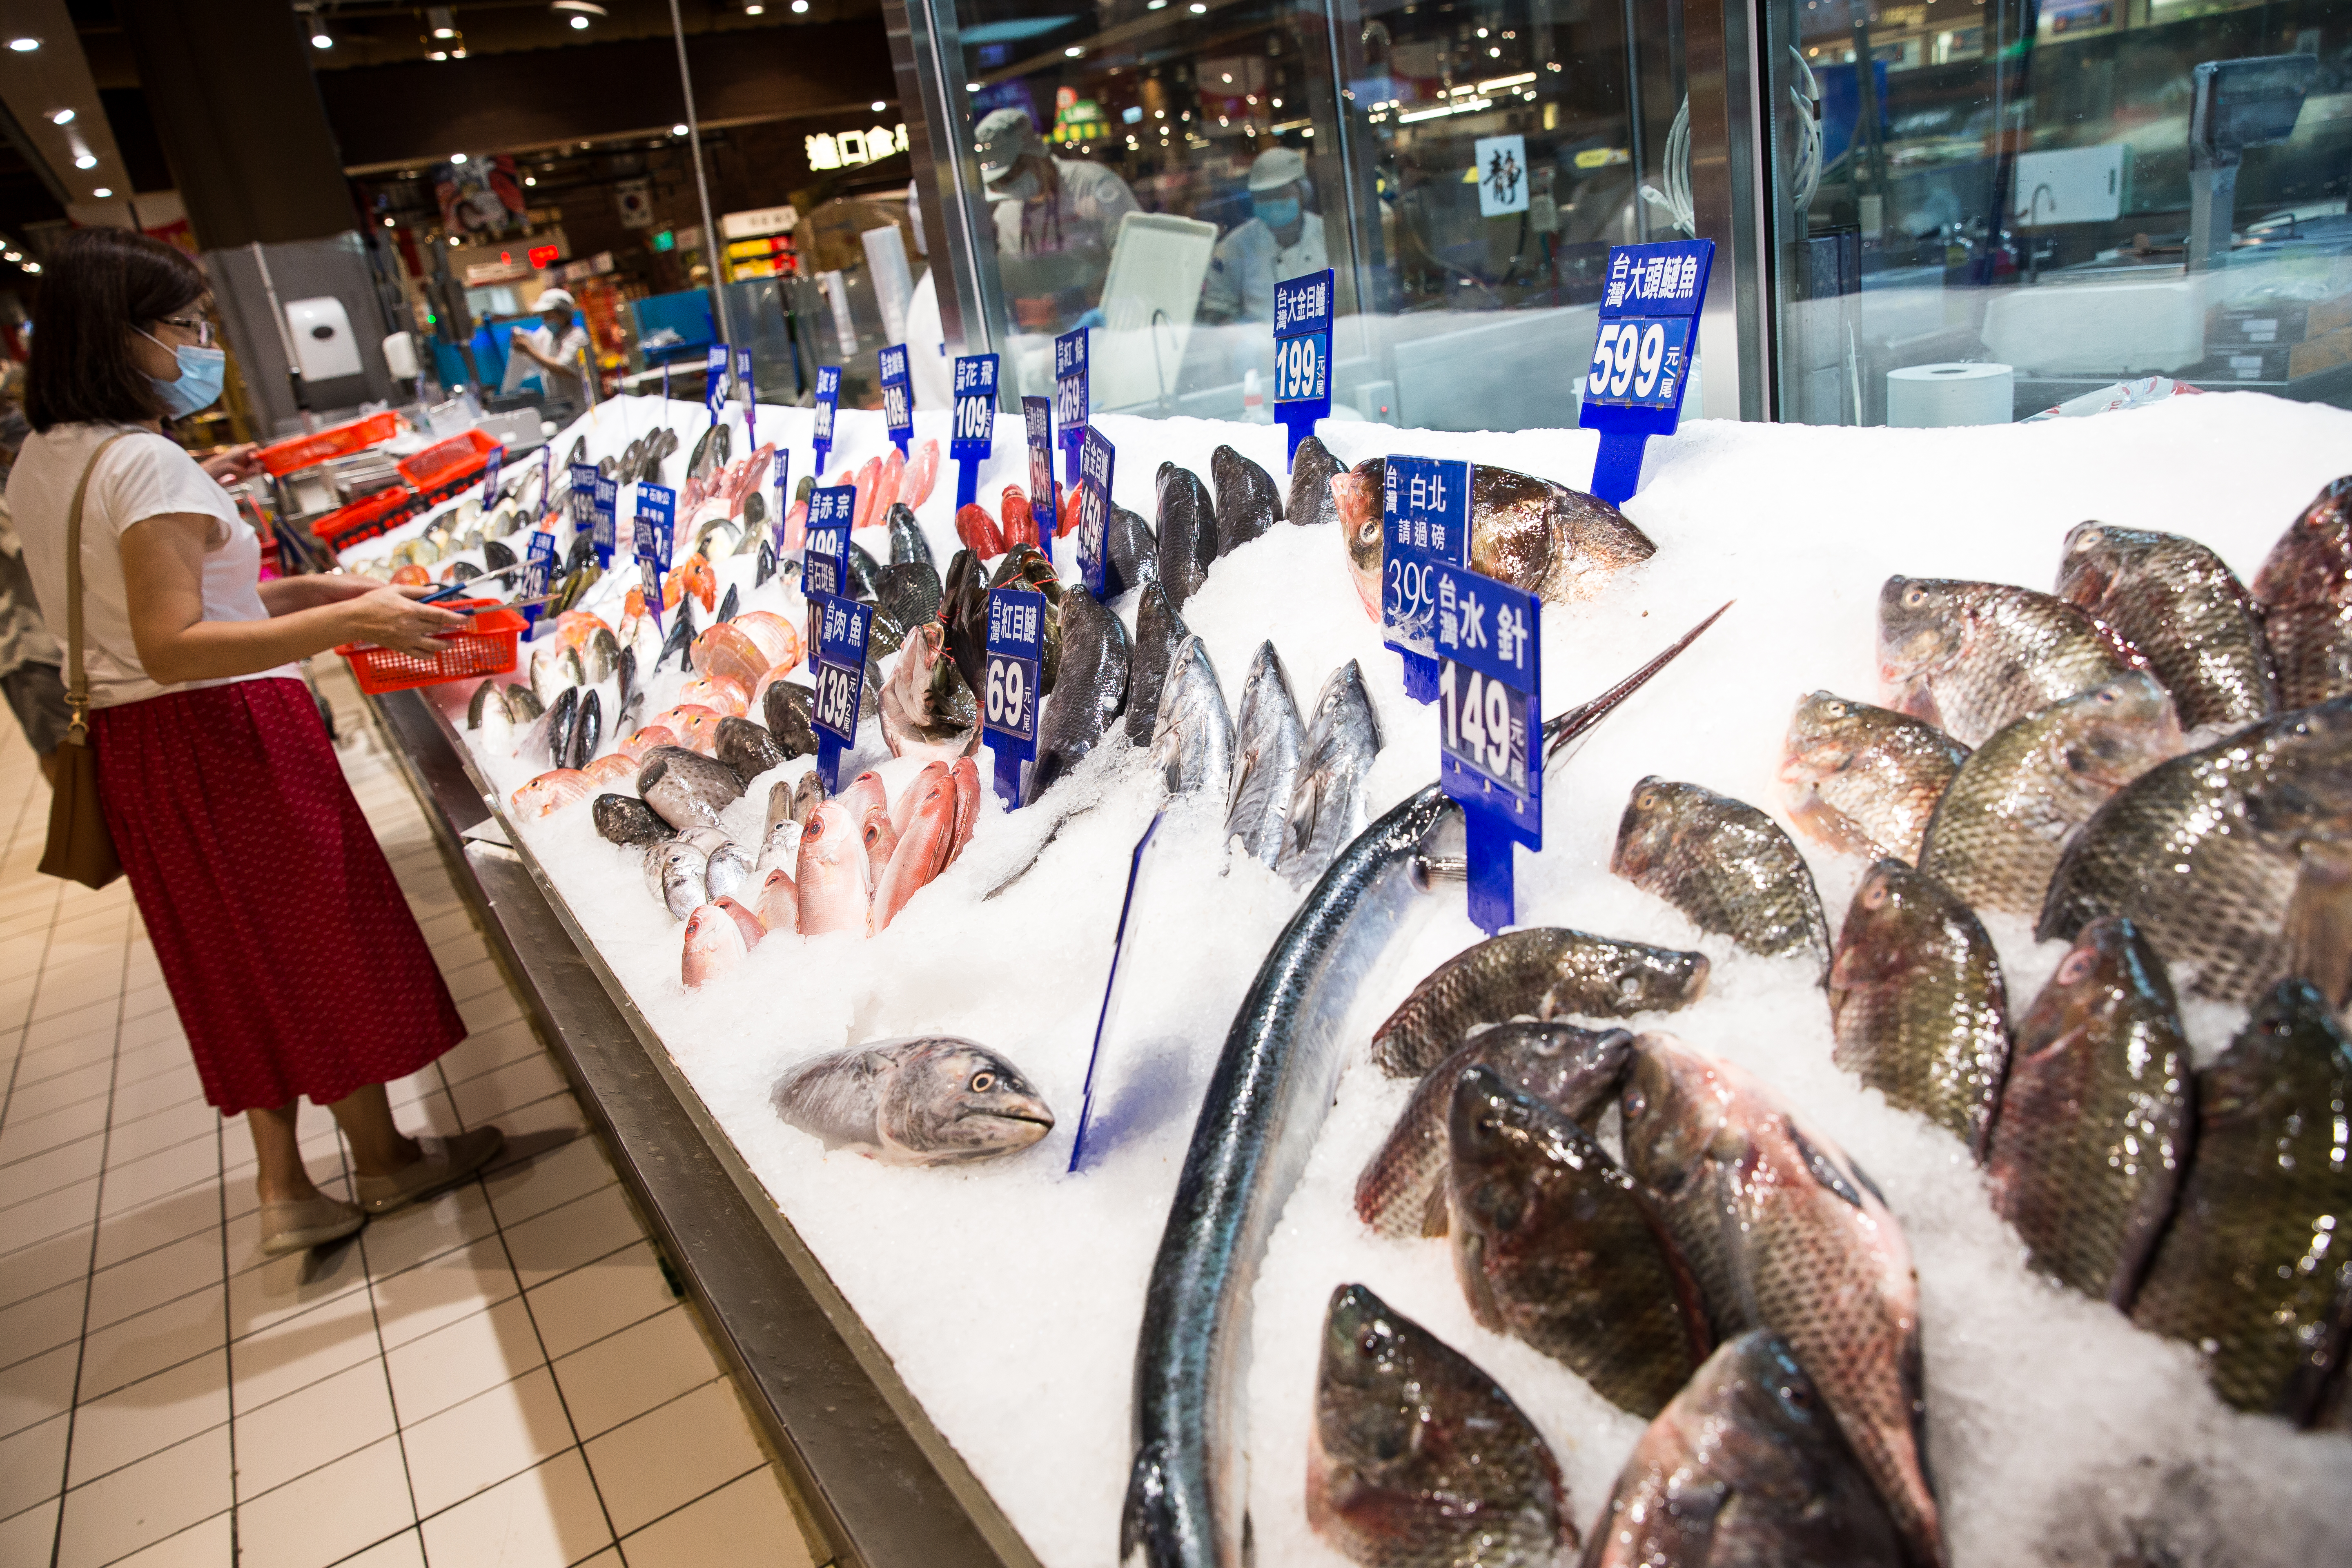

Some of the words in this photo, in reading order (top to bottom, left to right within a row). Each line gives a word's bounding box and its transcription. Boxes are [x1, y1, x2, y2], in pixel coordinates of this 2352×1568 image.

[1605, 253, 1630, 307] 台灣
[1625, 255, 1697, 300] 大頭鰱魚
[1276, 287, 1287, 331] 台灣
[1287, 282, 1325, 323] 大金目鱸
[956, 359, 966, 392] 台灣
[966, 360, 993, 387] 花飛
[1277, 339, 1315, 397] 199
[1590, 323, 1664, 398] 599
[1658, 347, 1680, 398] 元/尾
[884, 387, 904, 425] 189
[956, 395, 987, 438] 109
[1058, 376, 1080, 423] 269
[1083, 431, 1091, 476] 台灣
[808, 491, 821, 524] 台灣
[820, 493, 851, 520] 赤宗
[1386, 465, 1398, 514] 台灣
[1410, 473, 1446, 512] 白北
[1081, 485, 1100, 555] 159
[1398, 518, 1446, 551] 請過磅
[807, 555, 814, 593] 台灣
[814, 561, 835, 594] 石斑魚
[1387, 559, 1435, 624] 399
[808, 603, 822, 656] 18
[823, 600, 835, 643] 台灣
[832, 608, 862, 648] 肉魚
[990, 595, 1002, 644] 台灣
[1000, 602, 1037, 644] 紅目鰱
[1438, 573, 1459, 651] 台灣
[1459, 590, 1528, 670] 水針
[817, 666, 848, 728] 139
[987, 659, 1024, 727] 69
[1022, 686, 1031, 732] 元/尾
[1440, 660, 1510, 777] 149
